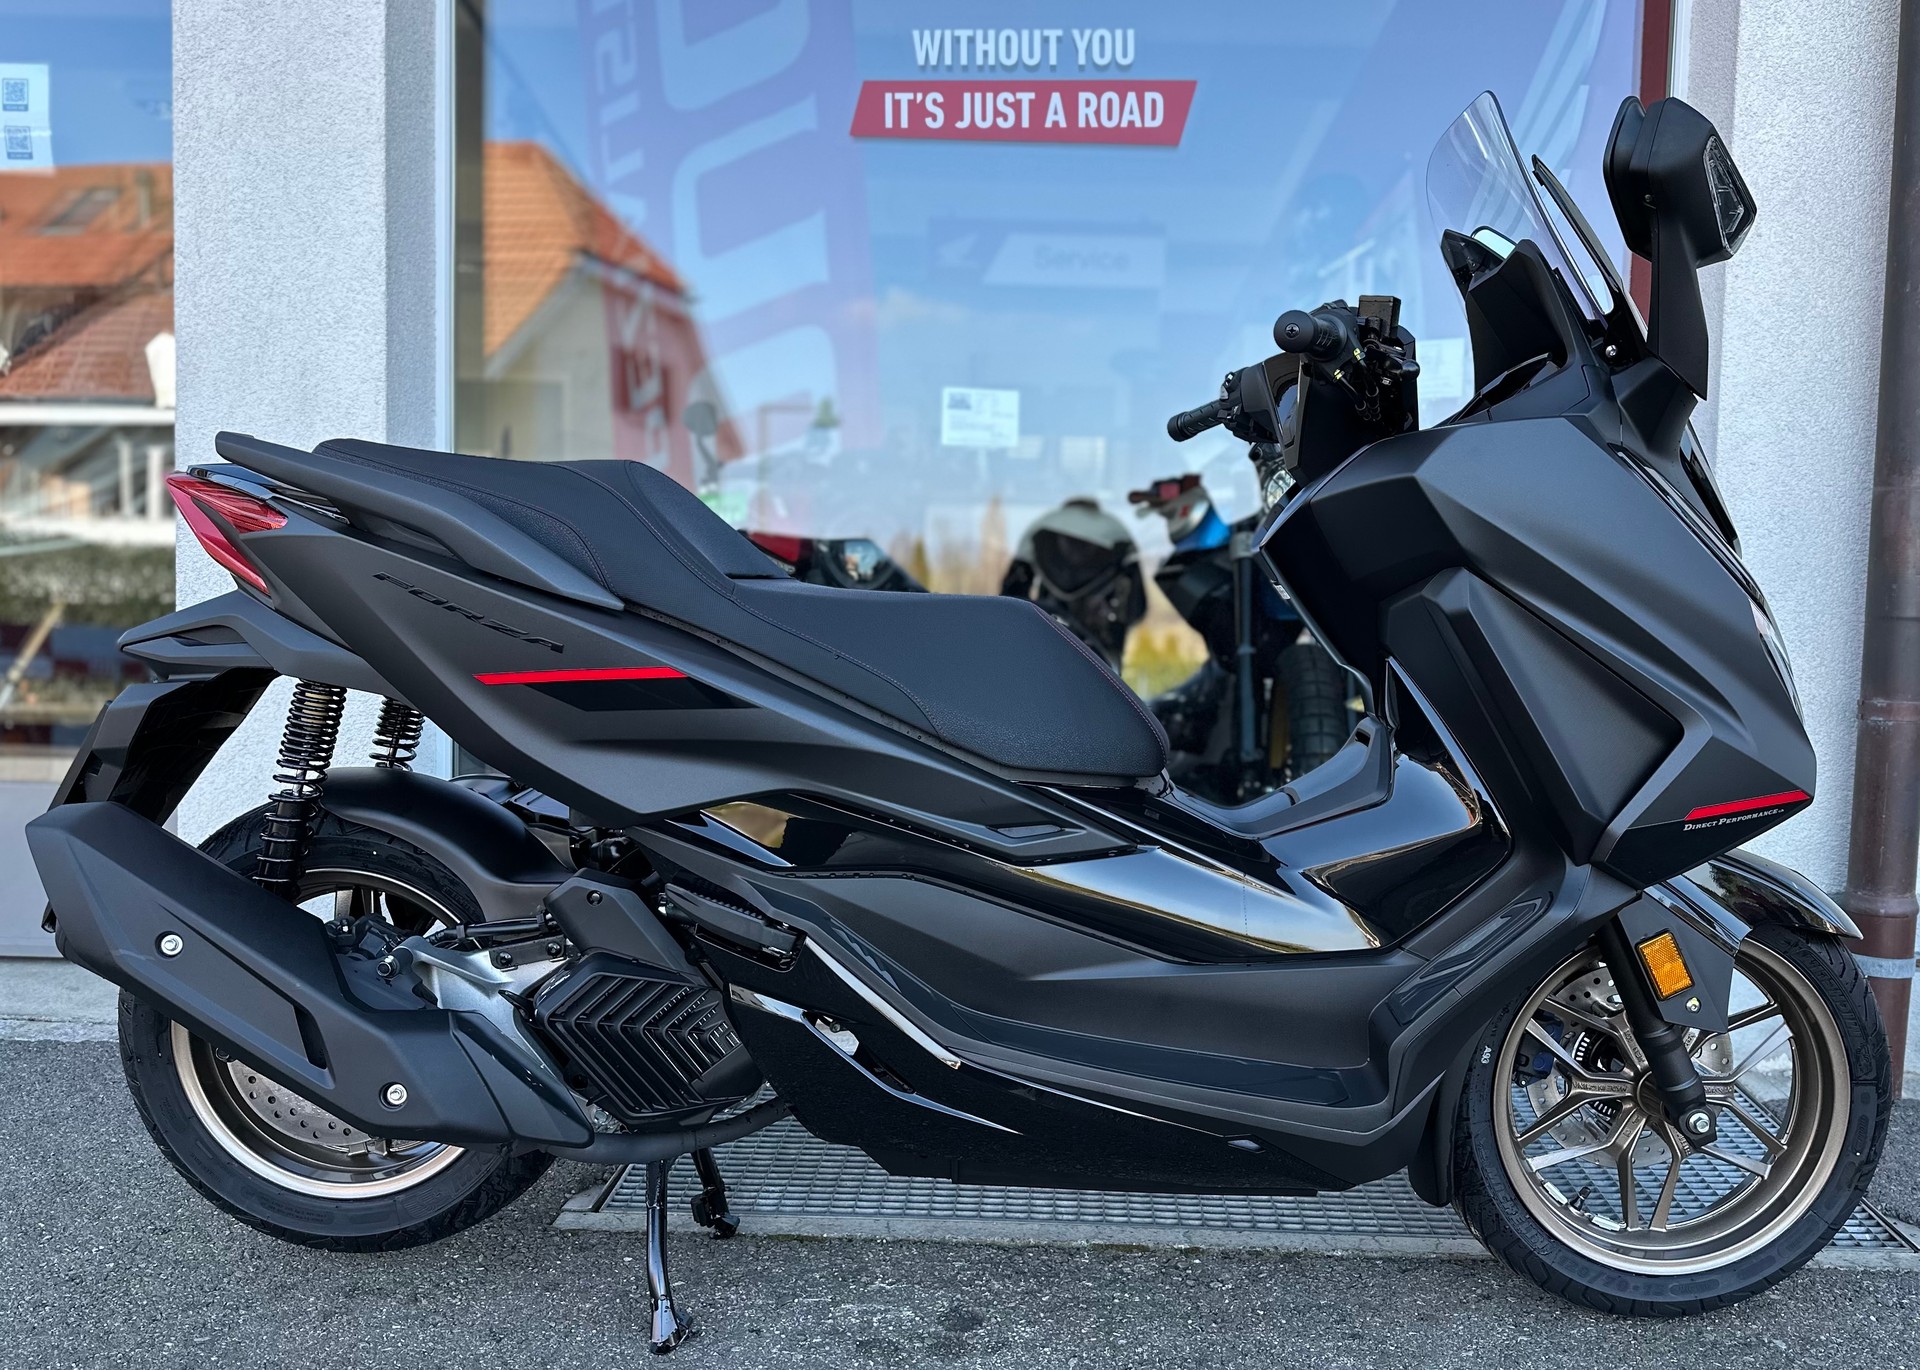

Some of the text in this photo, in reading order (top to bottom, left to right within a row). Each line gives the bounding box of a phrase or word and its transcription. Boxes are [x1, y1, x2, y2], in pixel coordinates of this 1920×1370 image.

[912, 28, 1135, 66] WITHOUT YOU
[884, 91, 1164, 129] IT'S JUST A ROAD
[1033, 244, 1130, 271] Service
[373, 571, 565, 653] FORZA
[1480, 1045, 1492, 1064] A93
